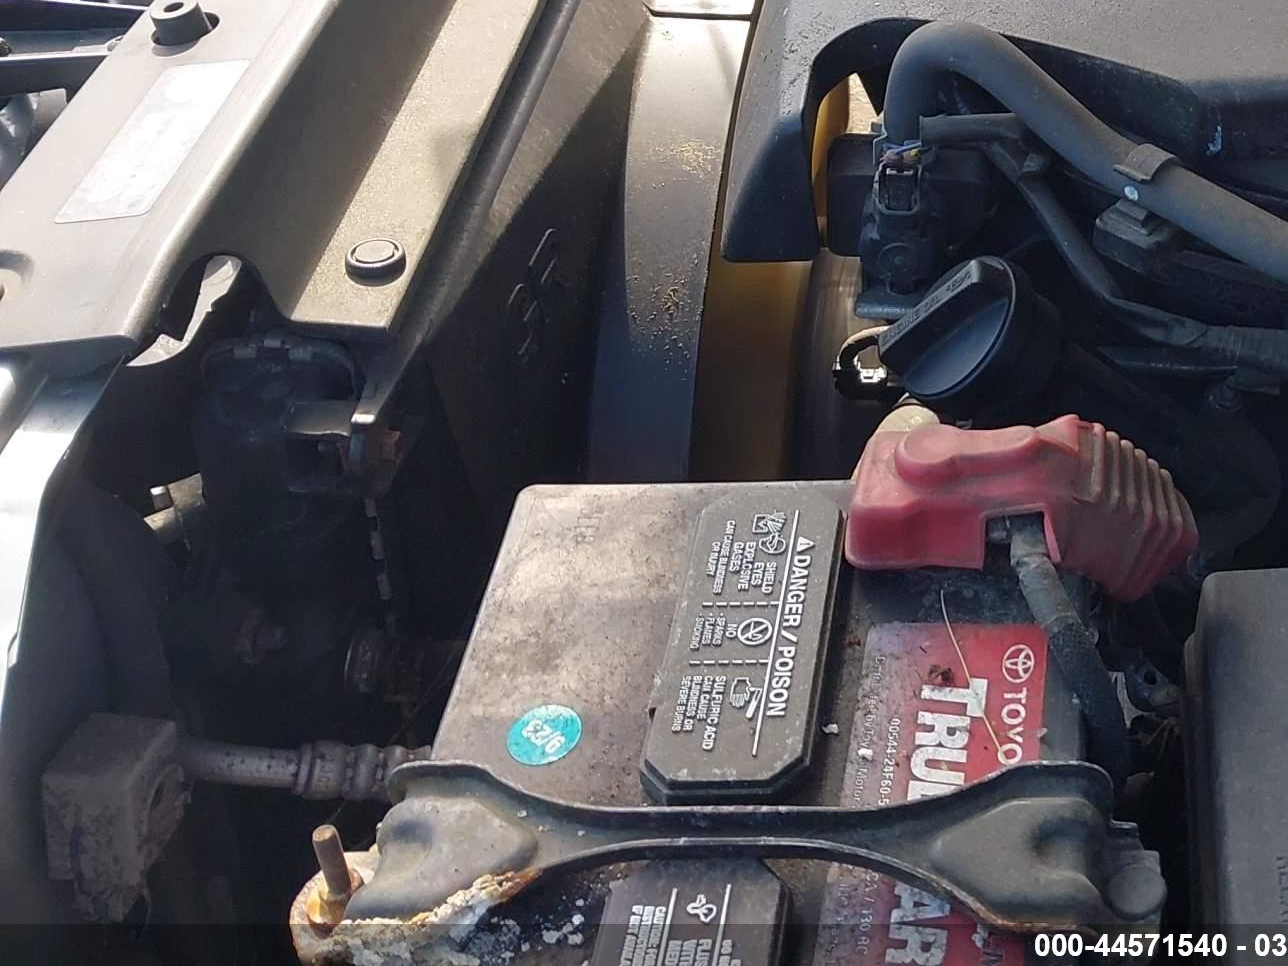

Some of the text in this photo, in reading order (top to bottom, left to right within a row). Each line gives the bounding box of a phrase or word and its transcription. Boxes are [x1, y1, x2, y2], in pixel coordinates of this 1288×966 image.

[725, 520, 736, 535] CAN
[721, 536, 733, 557] CAUSE
[728, 542, 744, 572] GASES
[738, 541, 756, 591] EXPLOSIVE
[751, 561, 765, 586] EYES
[761, 561, 777, 594] SHIELD
[783, 555, 811, 627] DANGER
[712, 618, 726, 646] SPARKS
[725, 623, 738, 639] NO
[766, 646, 796, 716] POISON
[697, 675, 713, 720] CAN CAUSE
[702, 675, 726, 750] SULFURIC ACID
[682, 719, 693, 731] OR
